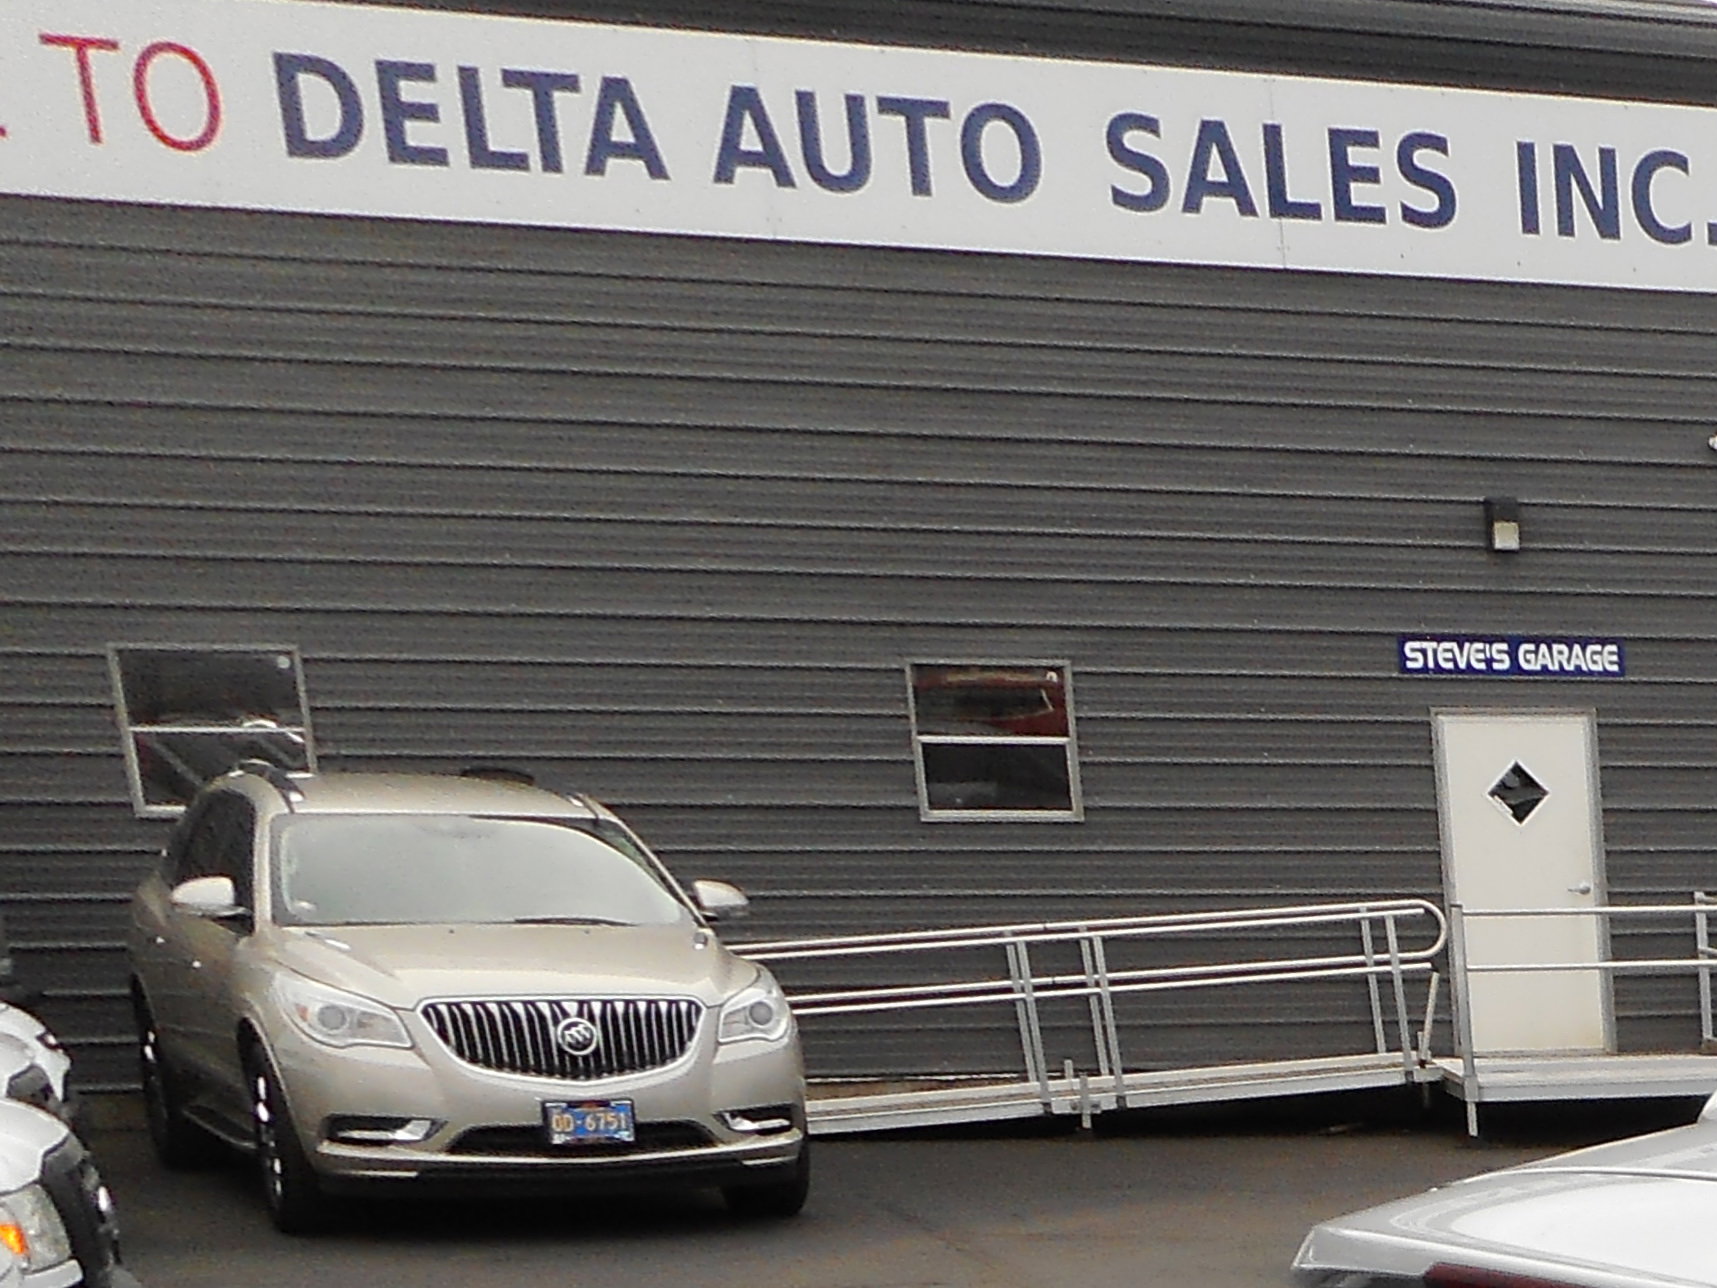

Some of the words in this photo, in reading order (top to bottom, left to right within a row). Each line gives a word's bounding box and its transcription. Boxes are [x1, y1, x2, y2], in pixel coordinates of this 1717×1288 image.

[38, 32, 223, 153] TO
[272, 50, 669, 181] DELTA
[712, 84, 1044, 205] AUTO
[1104, 111, 1458, 230] SALES
[1403, 640, 1511, 670] STEVE'S
[1518, 642, 1620, 672] GARAGE
